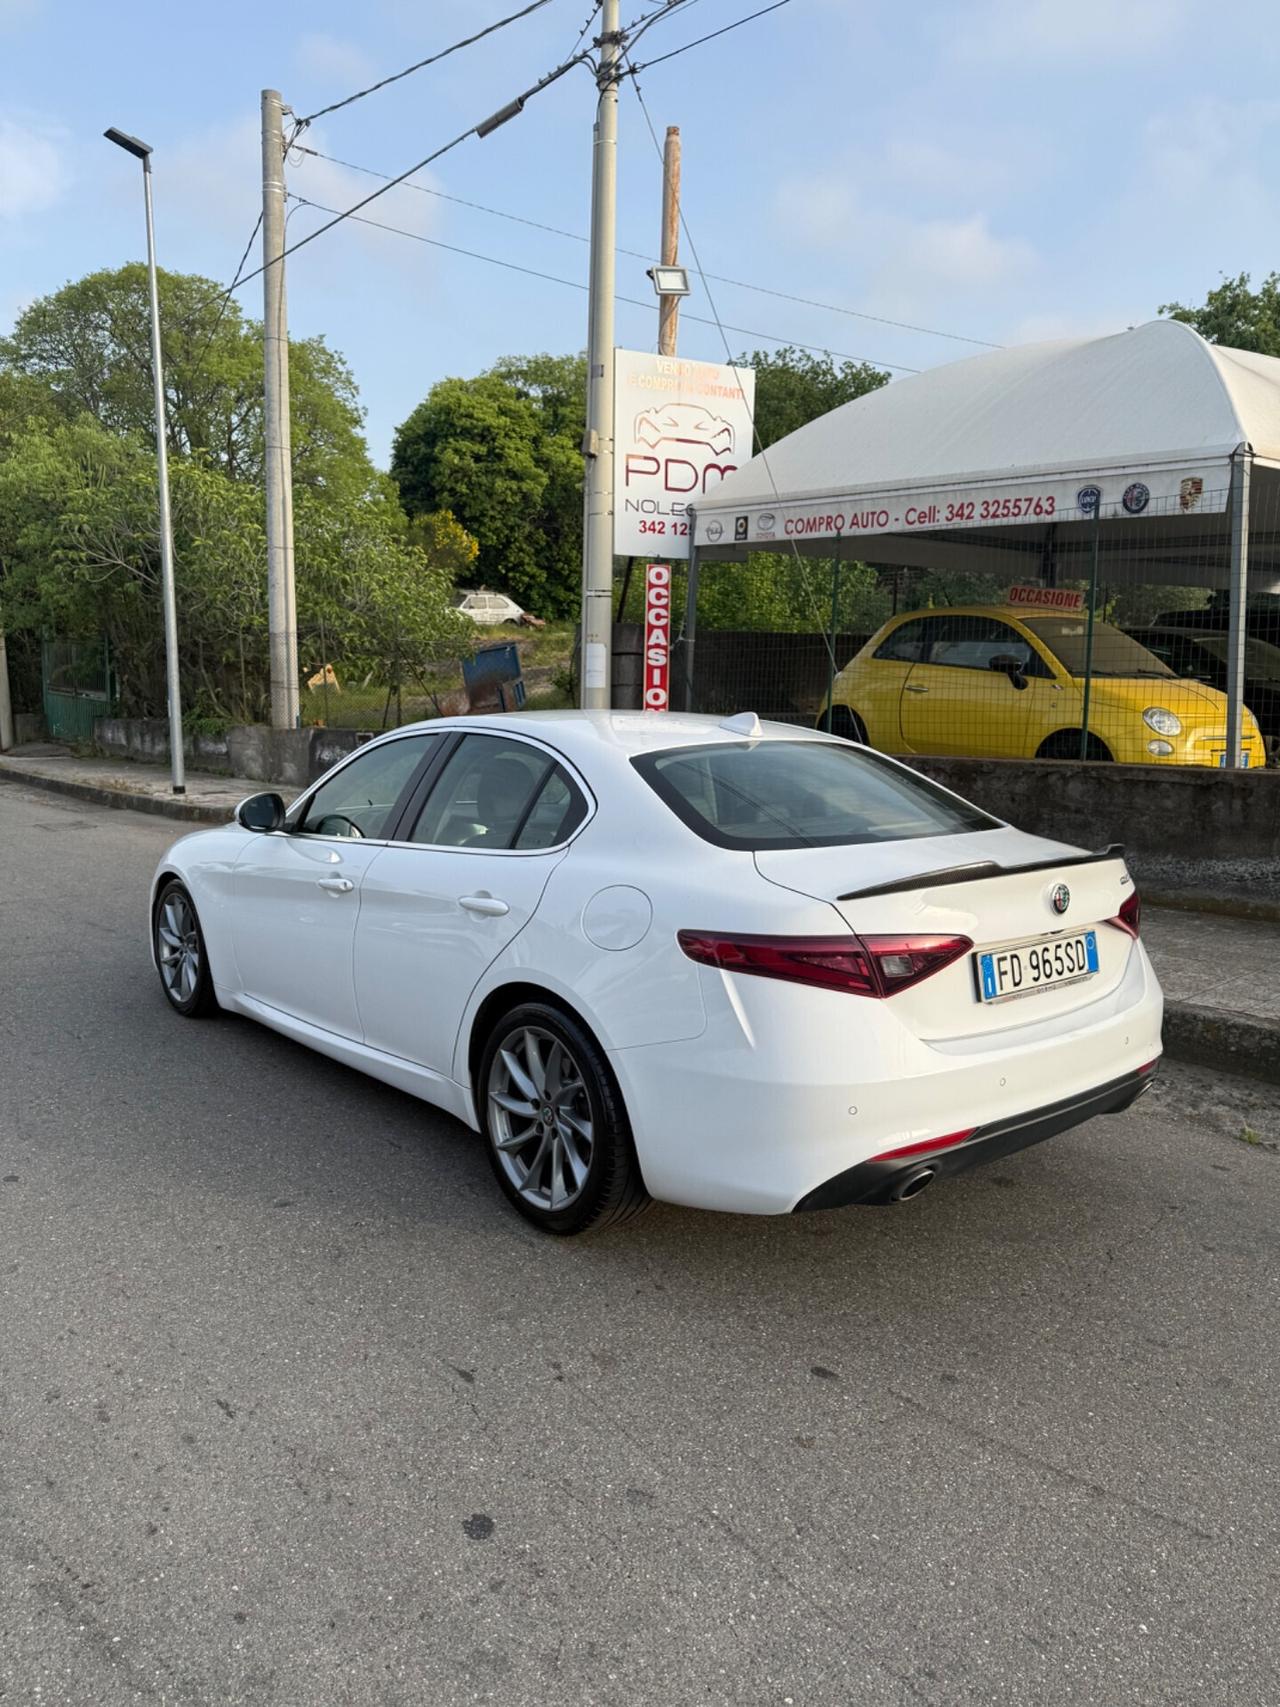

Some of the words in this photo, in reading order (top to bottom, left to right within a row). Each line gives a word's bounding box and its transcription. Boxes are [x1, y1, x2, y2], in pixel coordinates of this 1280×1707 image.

[639, 520, 666, 535] 342
[784, 513, 845, 535] COMPRO
[849, 510, 889, 529] AUTO
[905, 506, 940, 526] Cell:
[945, 503, 975, 522] 342
[980, 495, 1056, 519] 3255763
[1009, 587, 1082, 608] OCCASIONE
[645, 566, 670, 712] OCCASIO
[997, 953, 1022, 991] FD
[1029, 939, 1086, 983] 965SD
